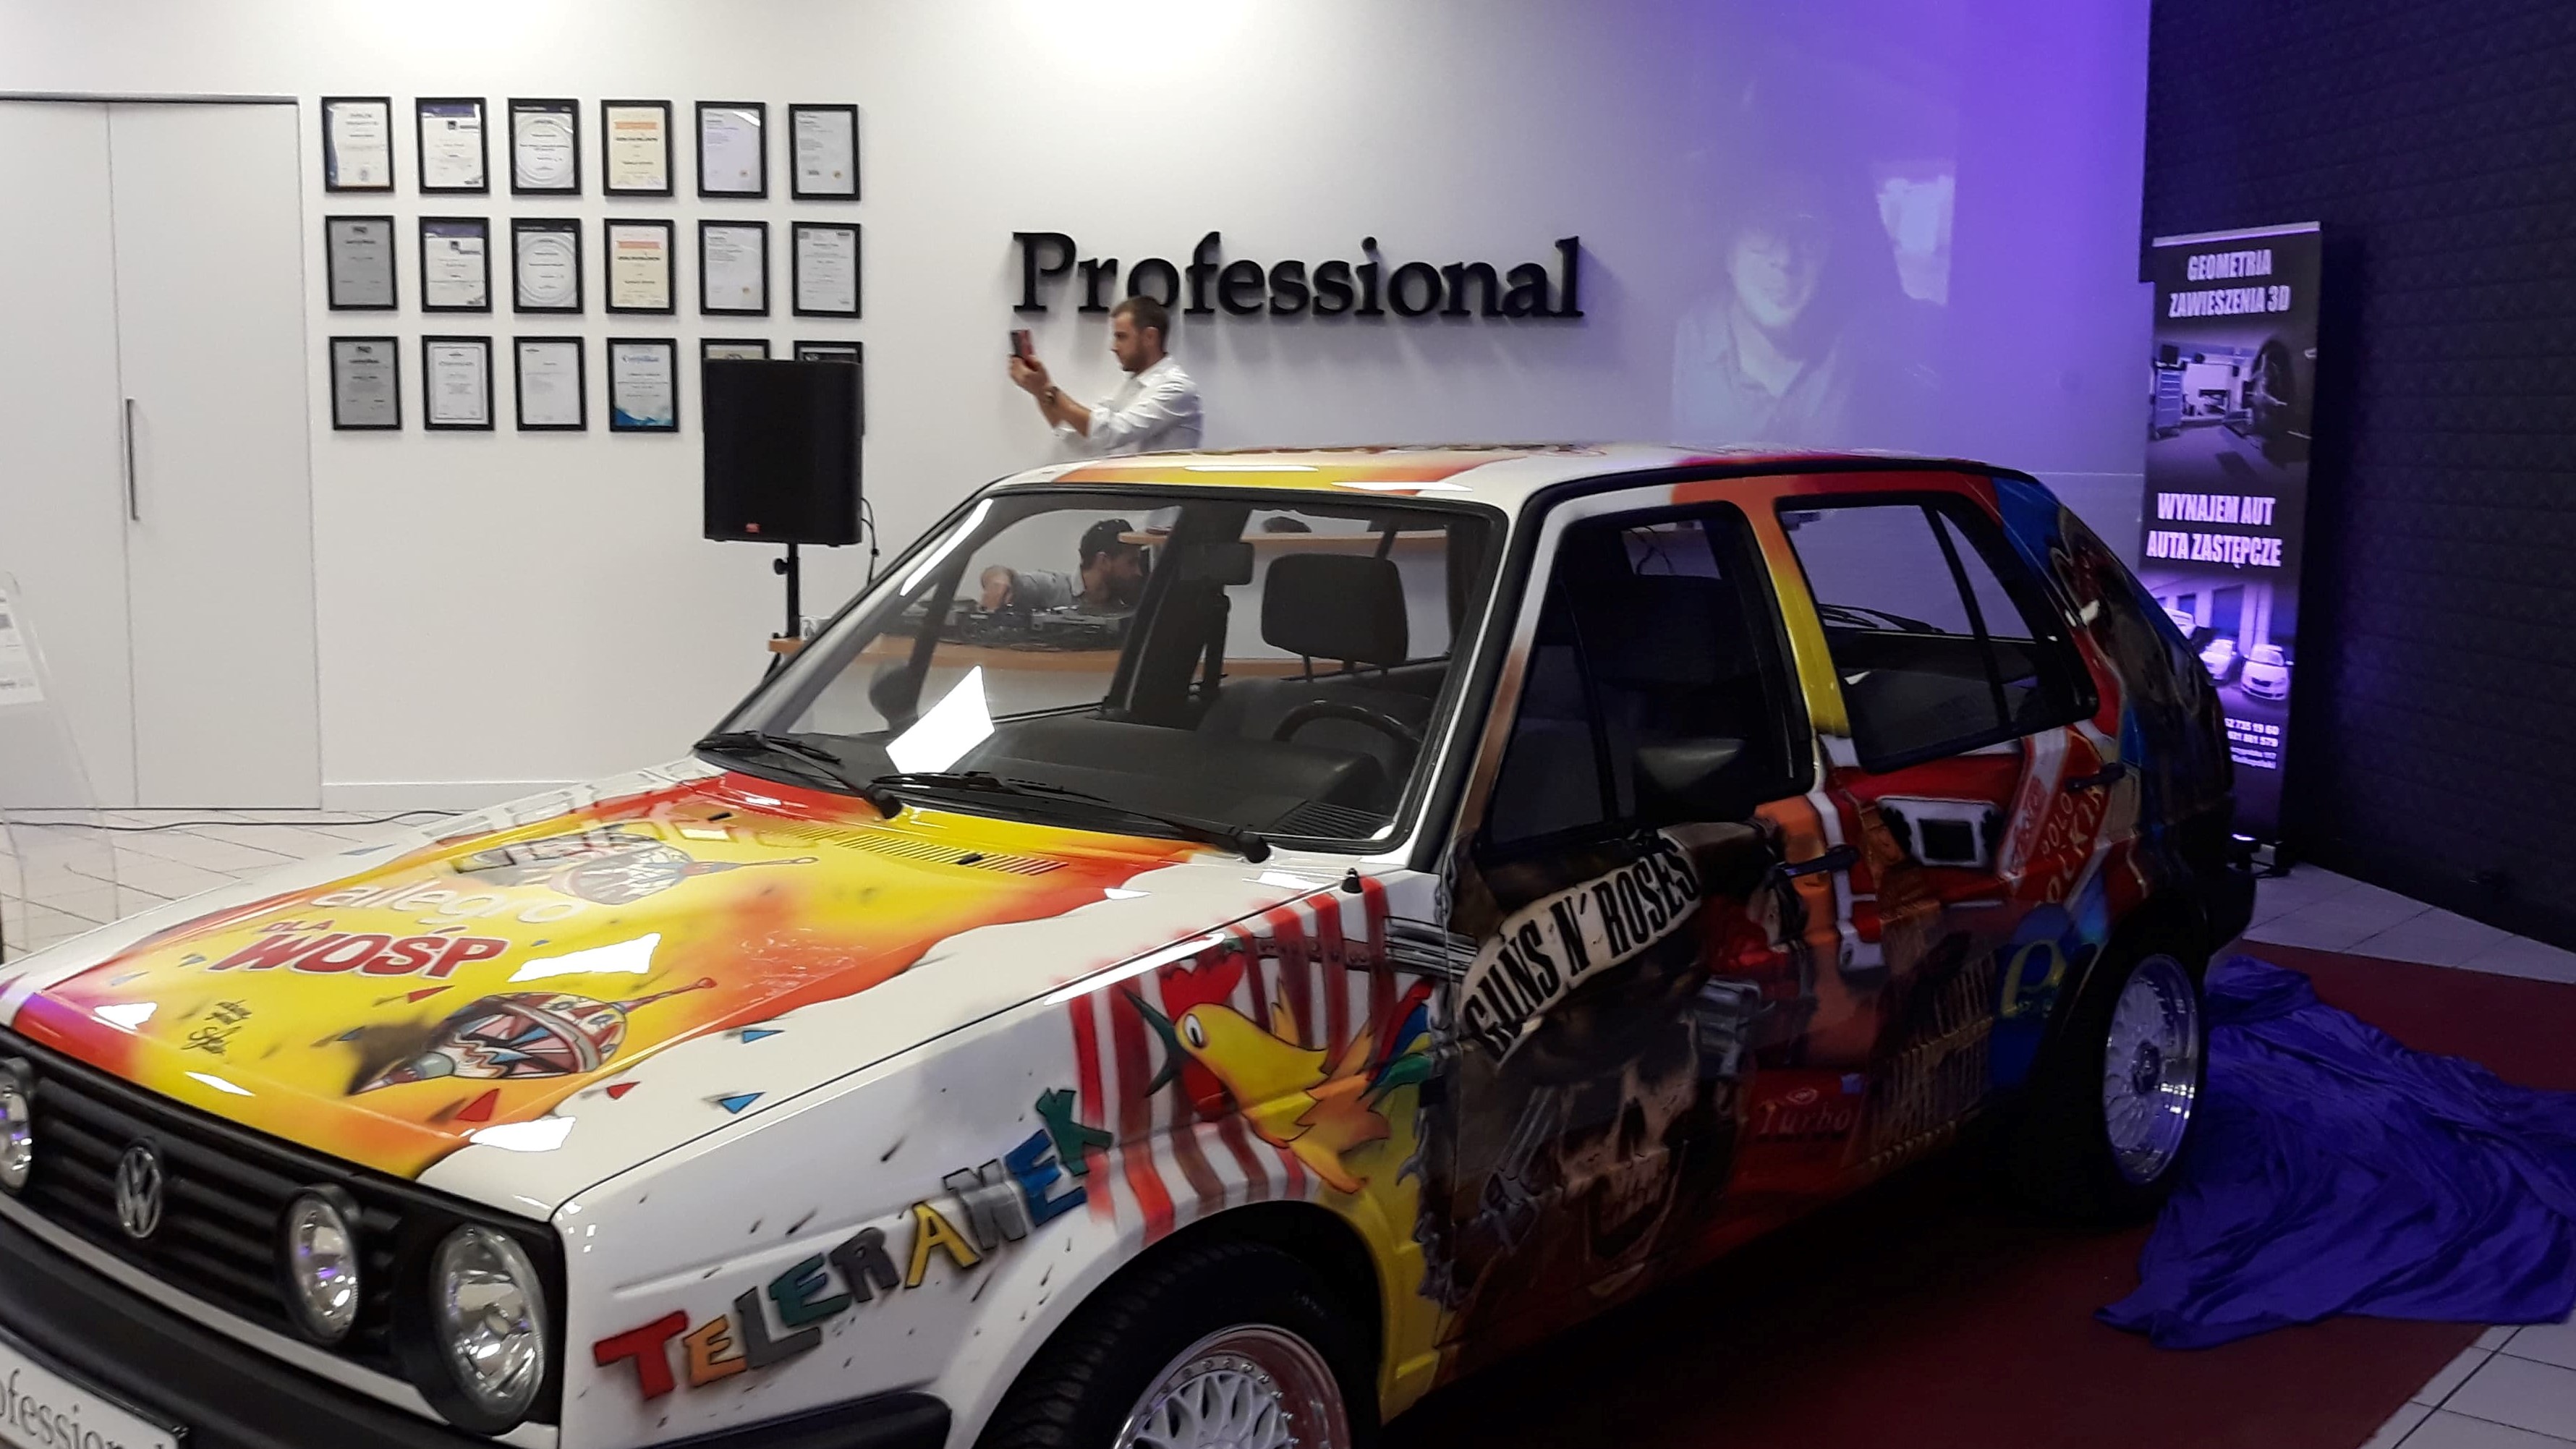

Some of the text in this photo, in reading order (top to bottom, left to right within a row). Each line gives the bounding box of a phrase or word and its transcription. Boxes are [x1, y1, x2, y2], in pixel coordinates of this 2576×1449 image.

[1013, 231, 1585, 318] Professional
[2186, 249, 2272, 281] GEOMETRIA
[2168, 285, 2291, 318] ZAWIESZENIA 3D
[2157, 493, 2276, 525] WYNAJEM AUT
[2146, 530, 2282, 569] AUTA ZASTĘPCZE
[309, 877, 590, 925] allegro
[262, 919, 335, 933] DLA
[205, 925, 510, 980] WOŚP
[1462, 919, 1561, 1061] GUNS
[1594, 838, 1699, 959] ROSES
[593, 1087, 1114, 1401] TELERANEK
